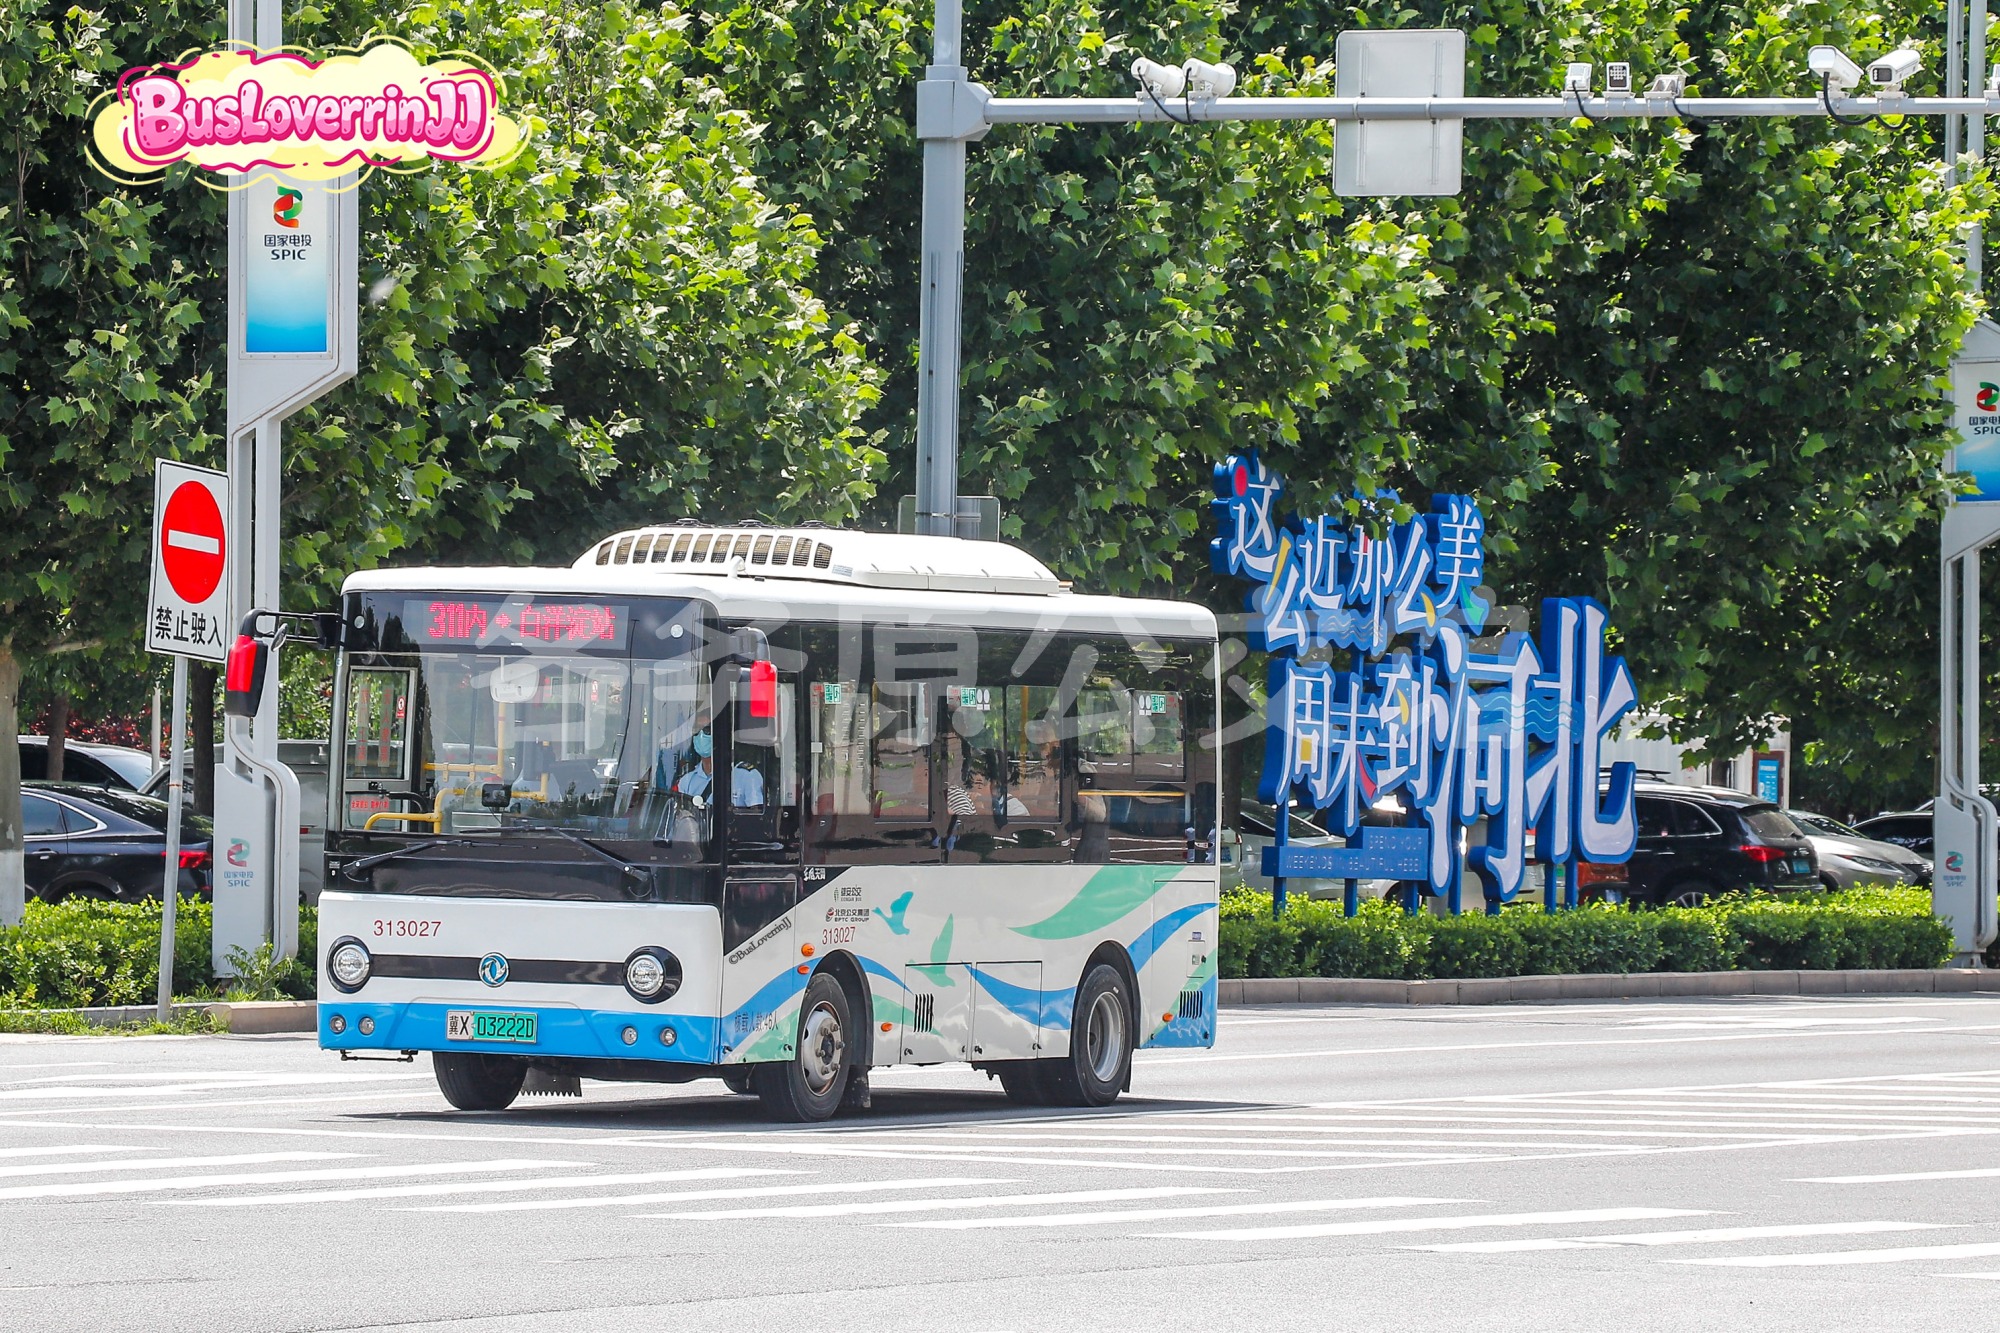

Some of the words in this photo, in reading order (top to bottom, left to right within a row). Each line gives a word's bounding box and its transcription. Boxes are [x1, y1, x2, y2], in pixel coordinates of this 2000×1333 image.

[264, 234, 312, 247] 国家电投
[271, 249, 306, 260] SPIC
[1969, 416, 2000, 425] 国家电
[155, 606, 222, 648] 禁止驶入
[428, 602, 488, 639] 311内
[519, 604, 617, 641] 白洋淀站
[1277, 604, 1637, 894] 周末到河北
[227, 879, 250, 887] SPIC
[835, 908, 870, 917] 北京公交集团
[373, 919, 442, 937] 313027
[822, 926, 856, 945] 313027
[448, 1015, 470, 1035] 冀X
[477, 1016, 534, 1038] 03222D
